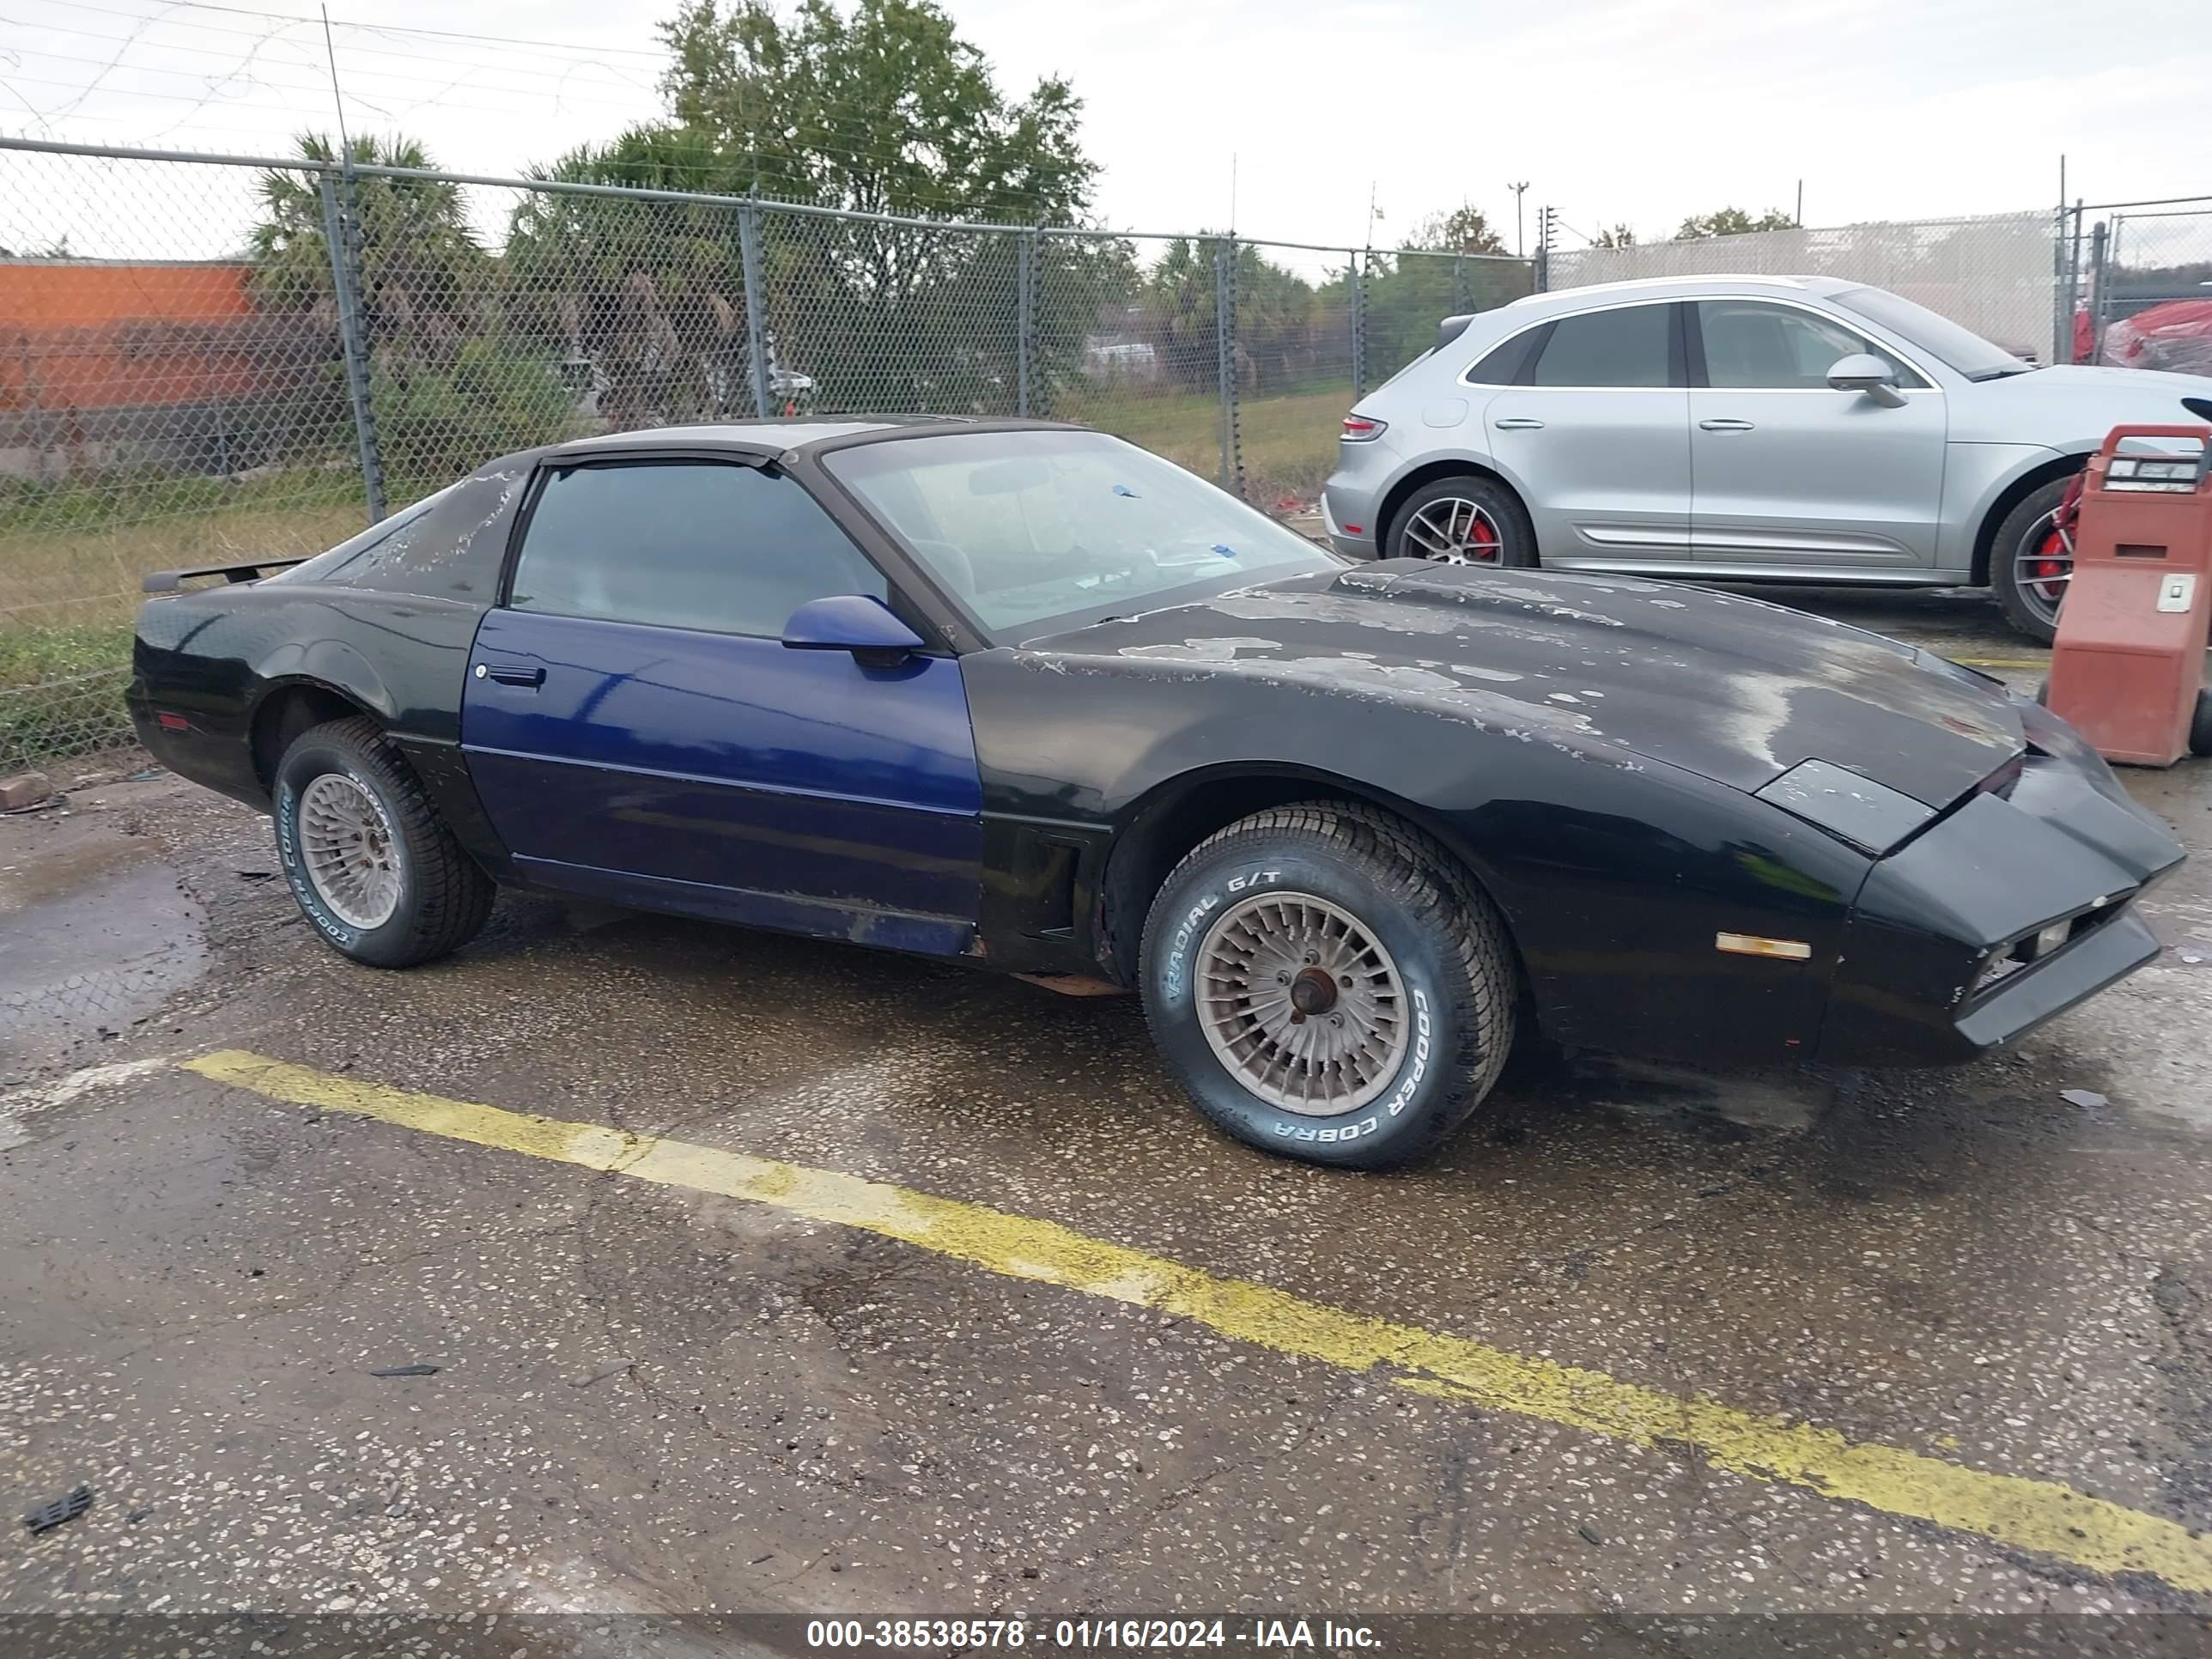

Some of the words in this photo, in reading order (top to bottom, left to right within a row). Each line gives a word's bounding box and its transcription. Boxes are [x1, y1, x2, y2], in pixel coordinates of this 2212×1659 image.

[1167, 896, 1218, 994] RADIAL
[1227, 871, 1281, 892] G/T
[1388, 988, 1431, 1117] COOPER
[1273, 1116, 1378, 1144] COBRA
